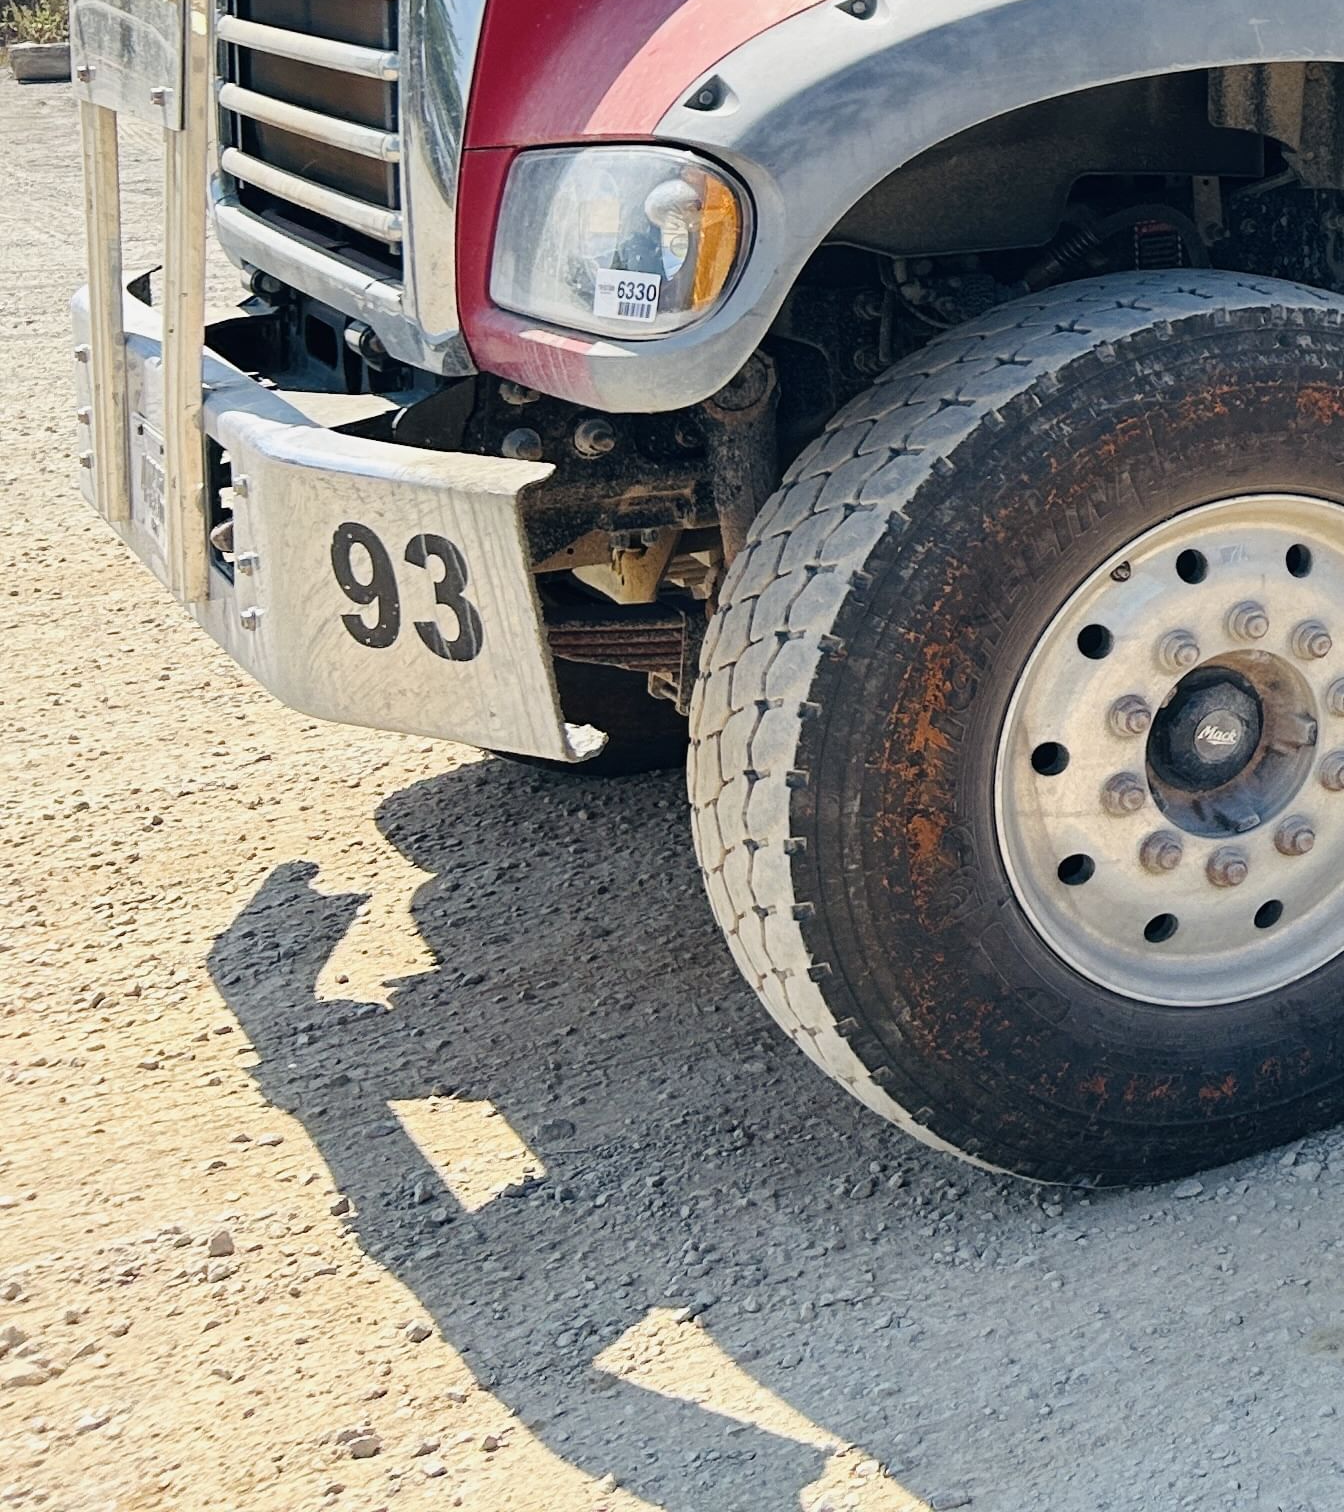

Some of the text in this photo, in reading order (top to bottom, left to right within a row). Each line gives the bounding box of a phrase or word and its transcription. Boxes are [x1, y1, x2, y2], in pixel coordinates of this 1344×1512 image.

[617, 281, 657, 302] 6330
[330, 522, 484, 662] 93
[1198, 725, 1237, 744] Mack
